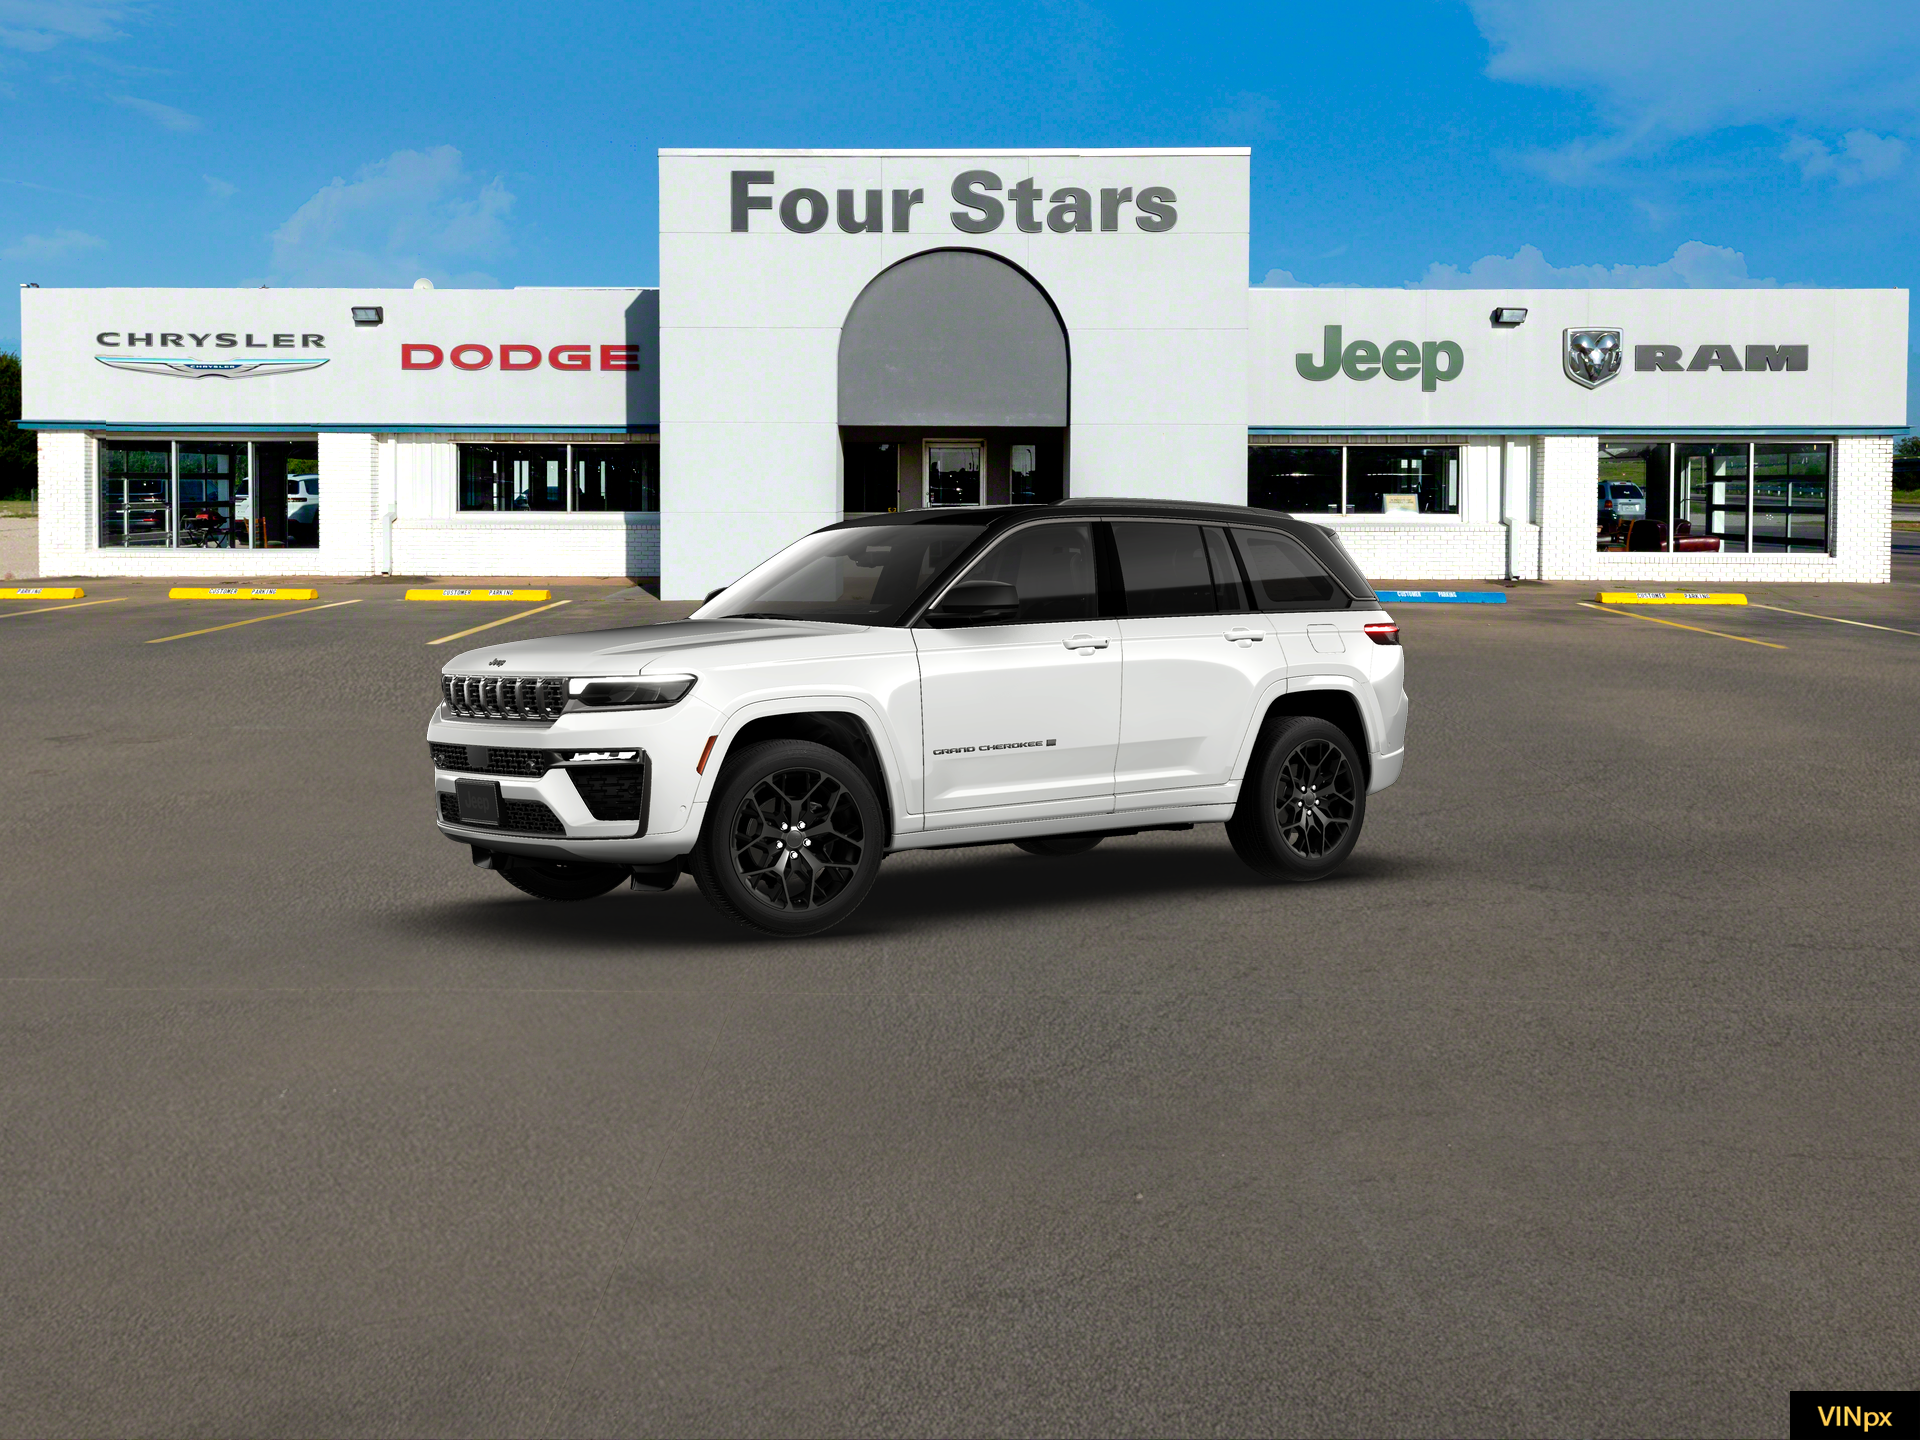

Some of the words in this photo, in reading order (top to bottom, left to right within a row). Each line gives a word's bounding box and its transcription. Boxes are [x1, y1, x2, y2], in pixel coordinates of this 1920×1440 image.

[731, 170, 924, 234] Four
[950, 169, 1179, 234] Stars
[96, 331, 327, 349] CHRYSLER
[401, 343, 641, 371] DODGE
[1295, 324, 1466, 393] Jeep
[1634, 343, 1809, 373] RAM
[933, 746, 975, 755] GRAND
[979, 741, 1043, 751] CHEROKEE
